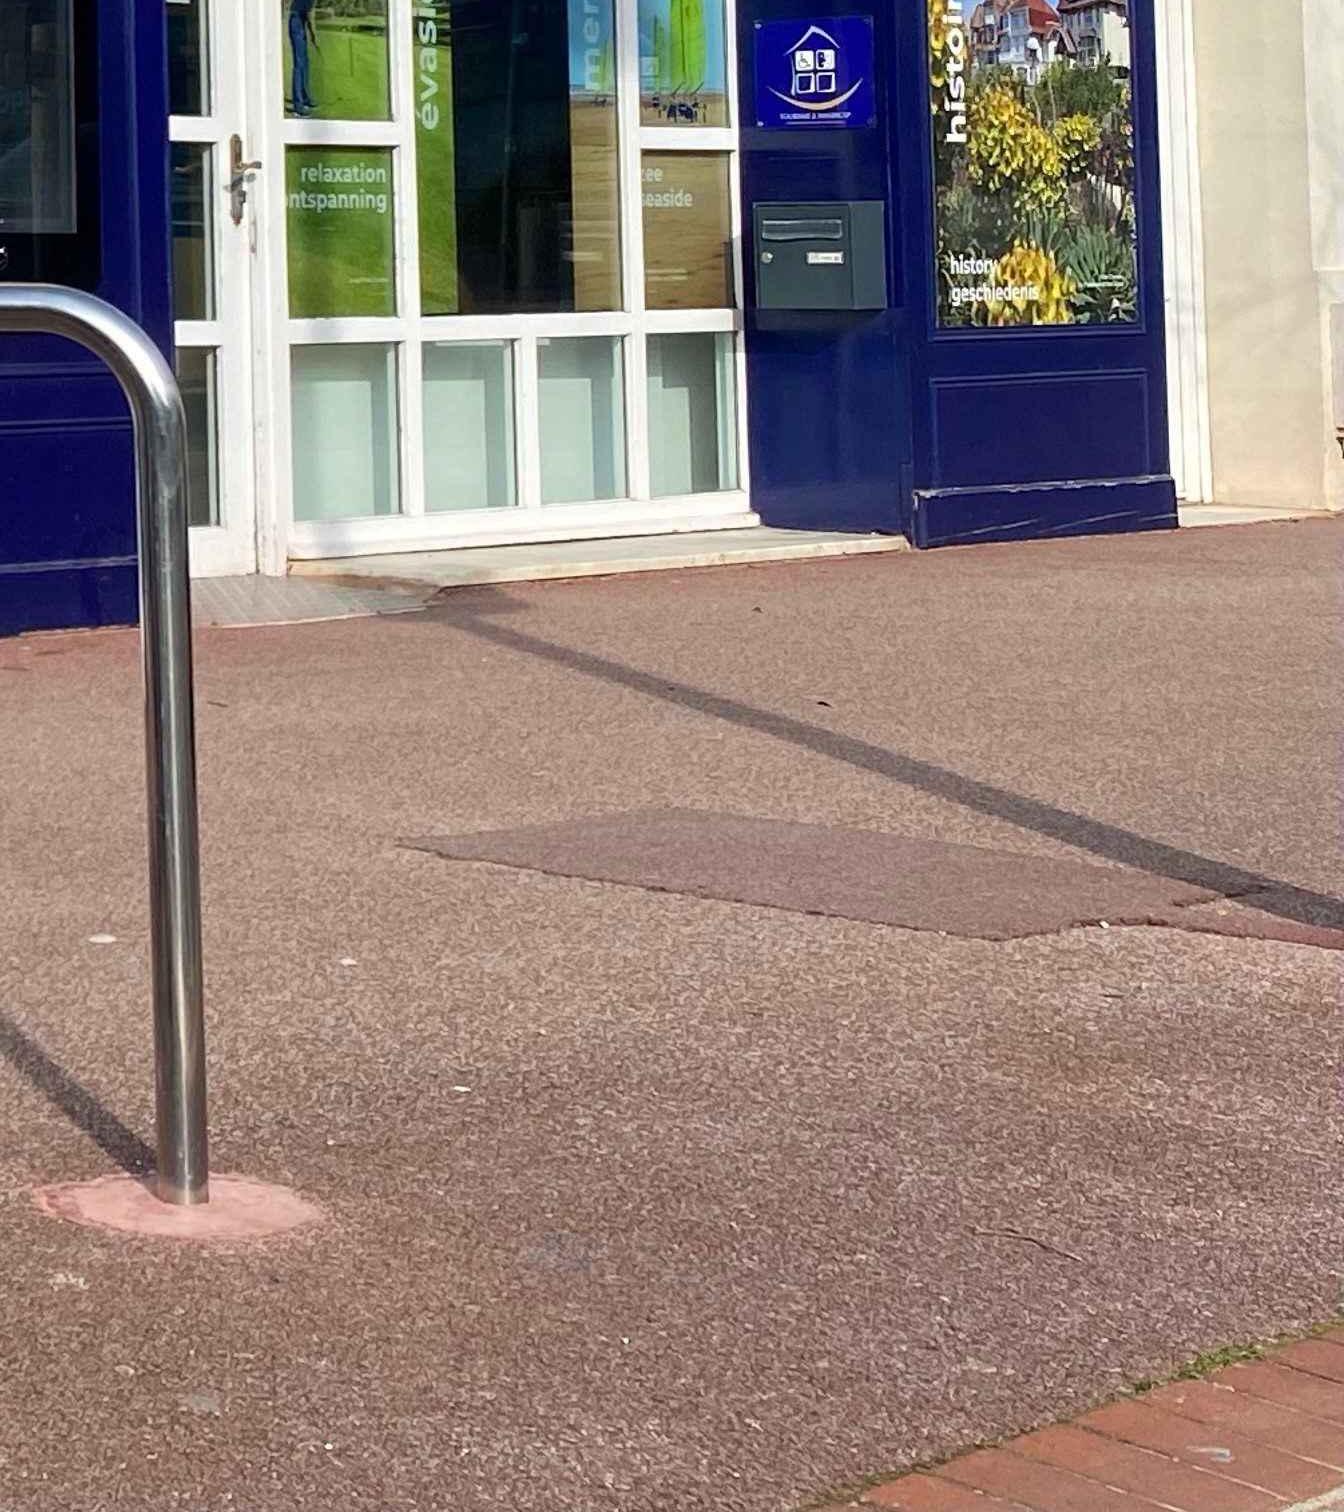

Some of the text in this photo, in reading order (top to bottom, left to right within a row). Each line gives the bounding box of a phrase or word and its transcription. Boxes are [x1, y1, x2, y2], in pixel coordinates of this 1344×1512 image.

[300, 163, 387, 183] relaxation
[287, 189, 387, 213] ntspanning
[952, 282, 1040, 307] geschiedenis
